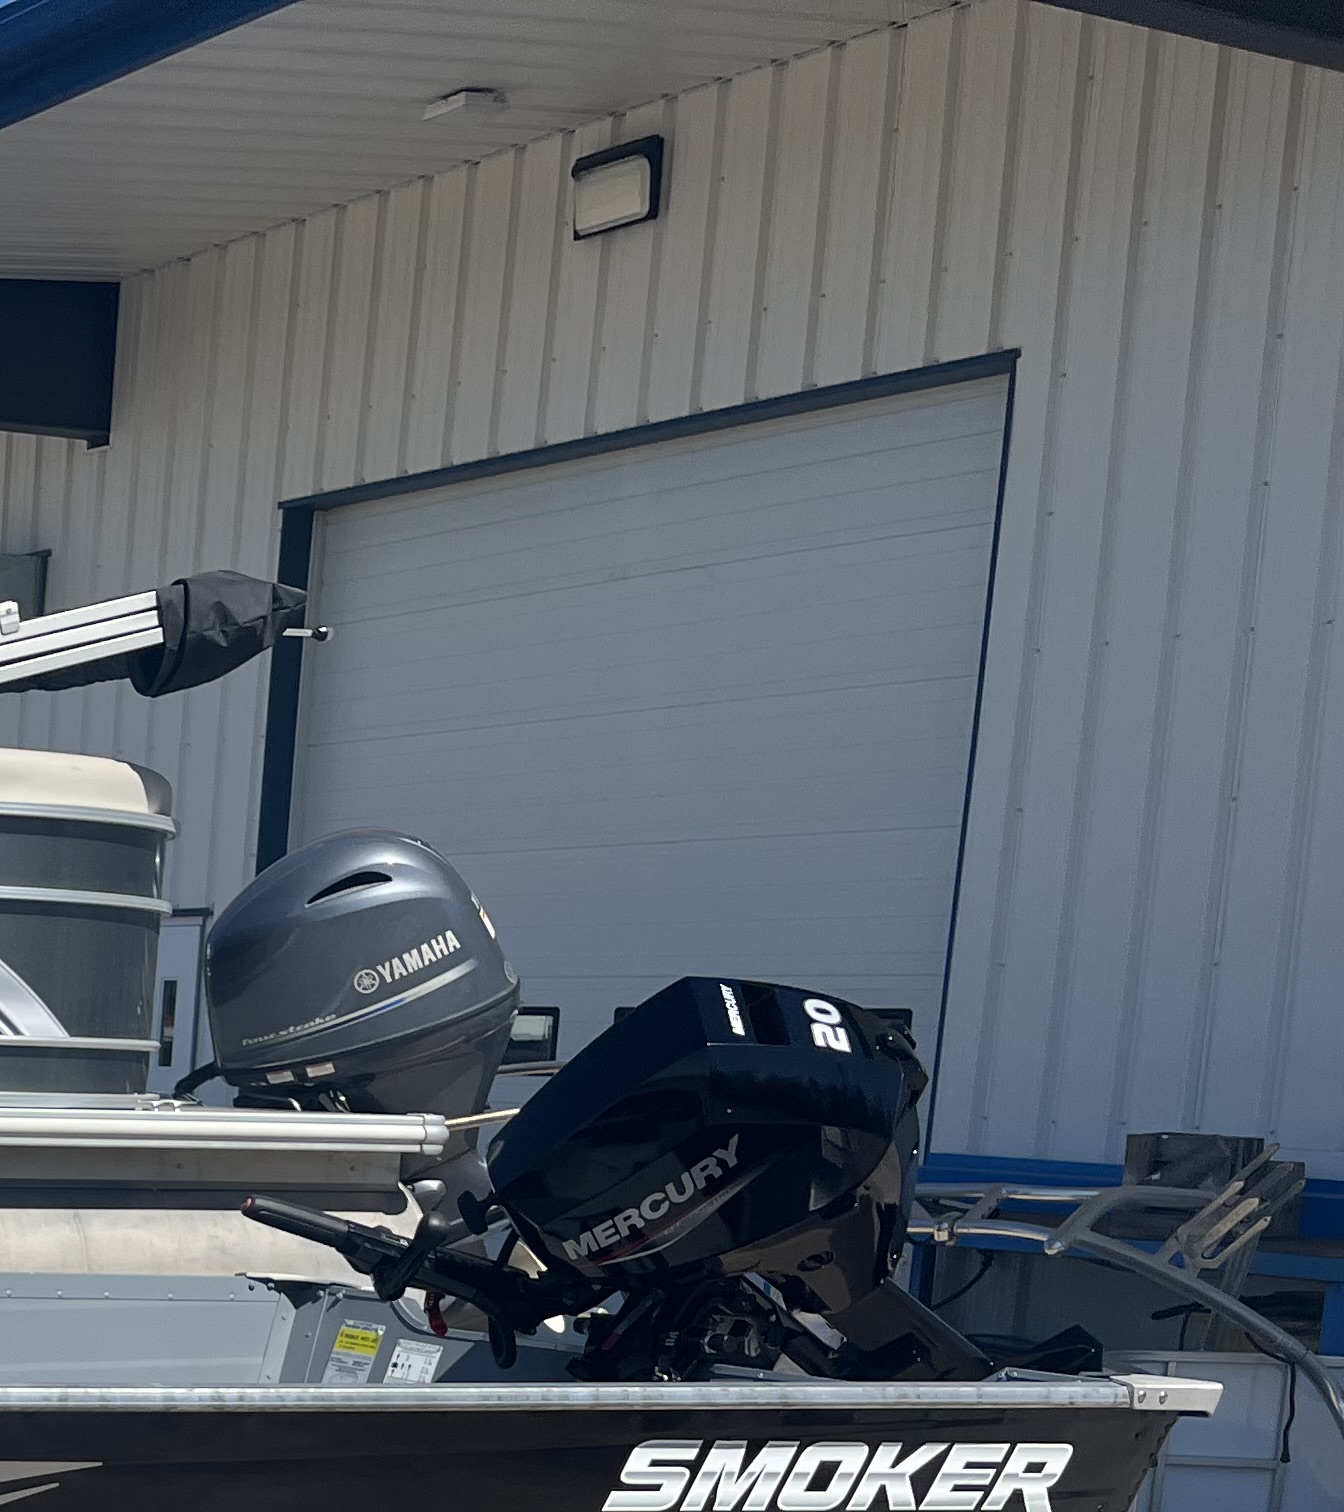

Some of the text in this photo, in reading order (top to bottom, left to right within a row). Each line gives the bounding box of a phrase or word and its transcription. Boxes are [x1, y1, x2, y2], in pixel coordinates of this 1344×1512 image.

[375, 929, 461, 984] YAMAHA
[803, 998, 853, 1054] 20
[562, 1132, 740, 1261] MERCURY
